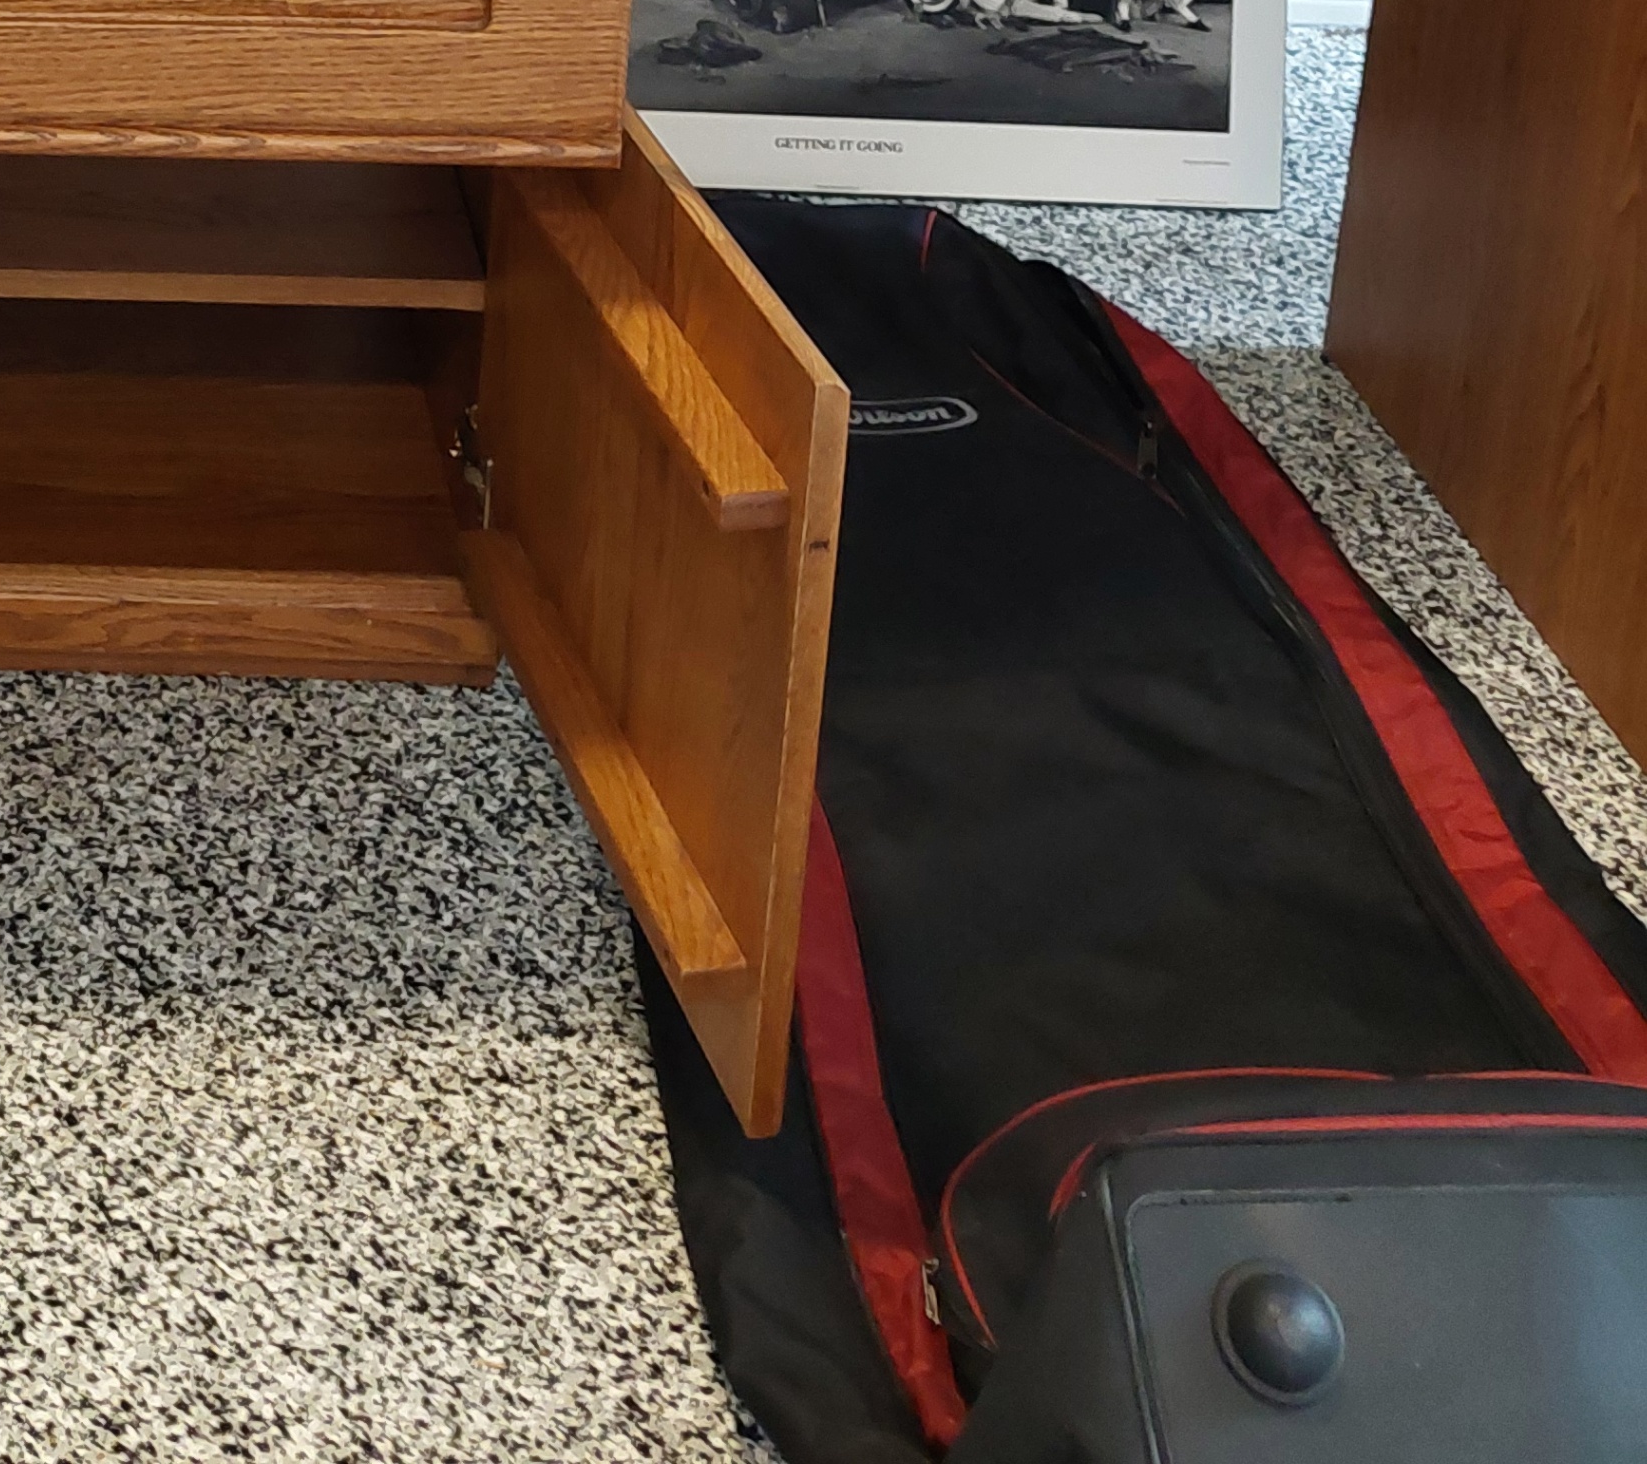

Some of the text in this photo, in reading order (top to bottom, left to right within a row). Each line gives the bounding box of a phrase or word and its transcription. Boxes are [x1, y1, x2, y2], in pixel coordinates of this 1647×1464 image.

[774, 137, 903, 154] GETTING IT GOING
